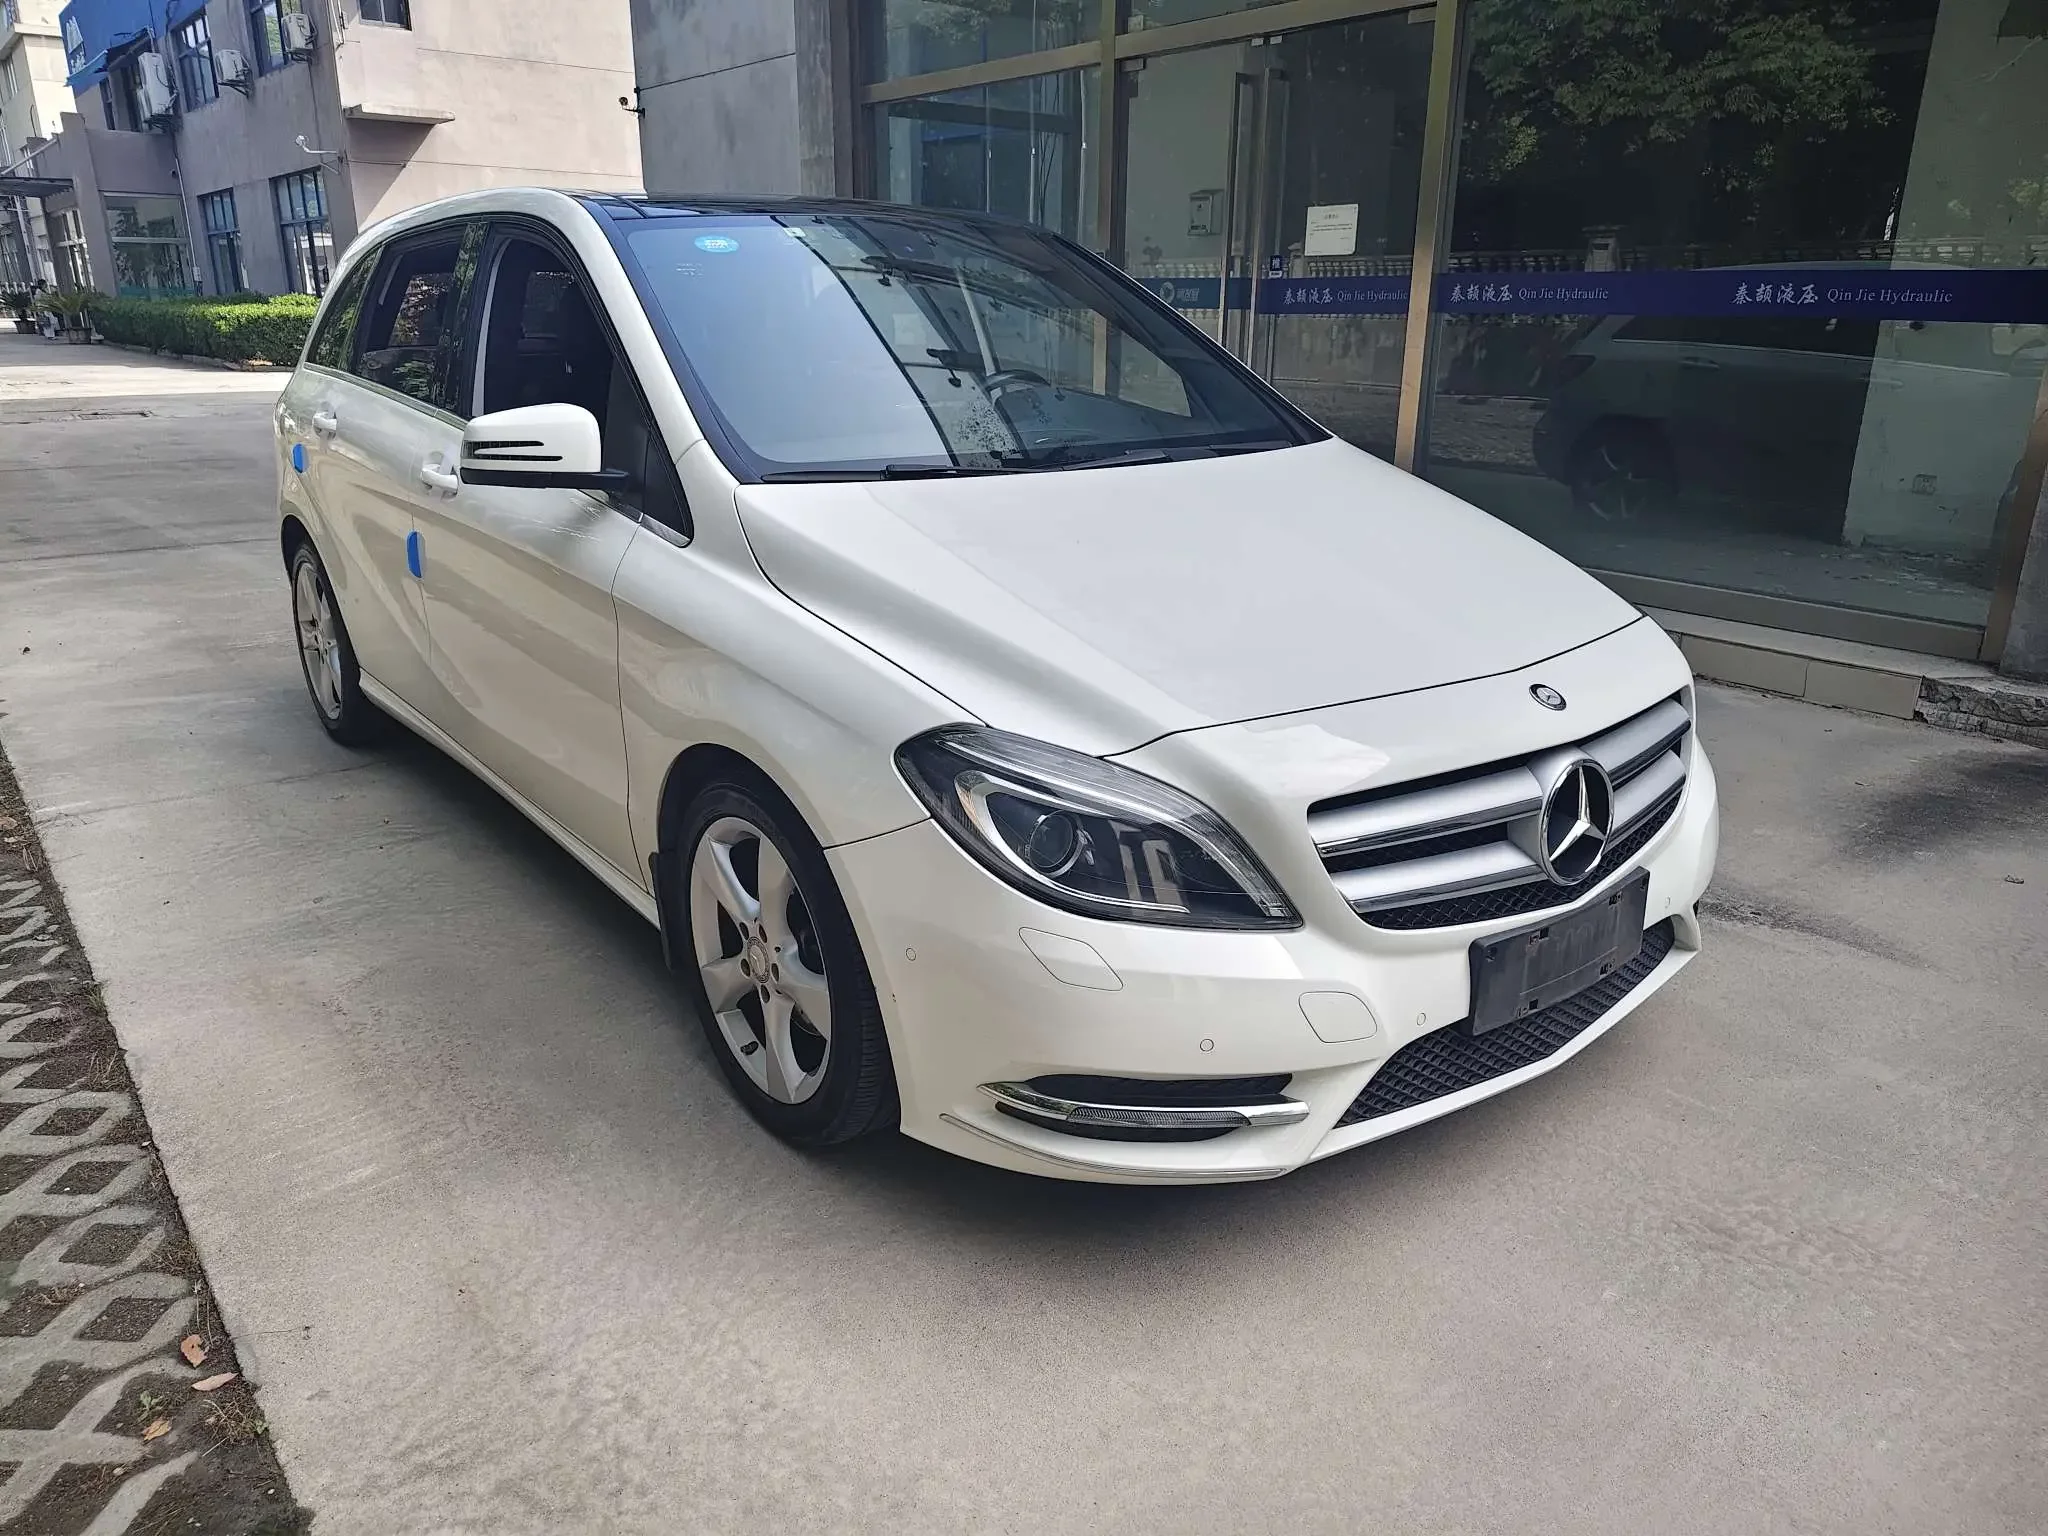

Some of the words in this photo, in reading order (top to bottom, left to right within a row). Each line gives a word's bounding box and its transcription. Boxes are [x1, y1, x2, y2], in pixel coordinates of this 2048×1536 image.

[1337, 290, 1352, 302] Qin
[1367, 289, 1409, 302] Hydraulic
[1518, 288, 1537, 300] Qin
[1539, 288, 1553, 299] Jie
[1556, 287, 1609, 301] Hydraulic
[1827, 288, 1852, 301] Qin
[1855, 288, 1876, 301] Jie
[1880, 288, 1953, 304] Hydraulic
